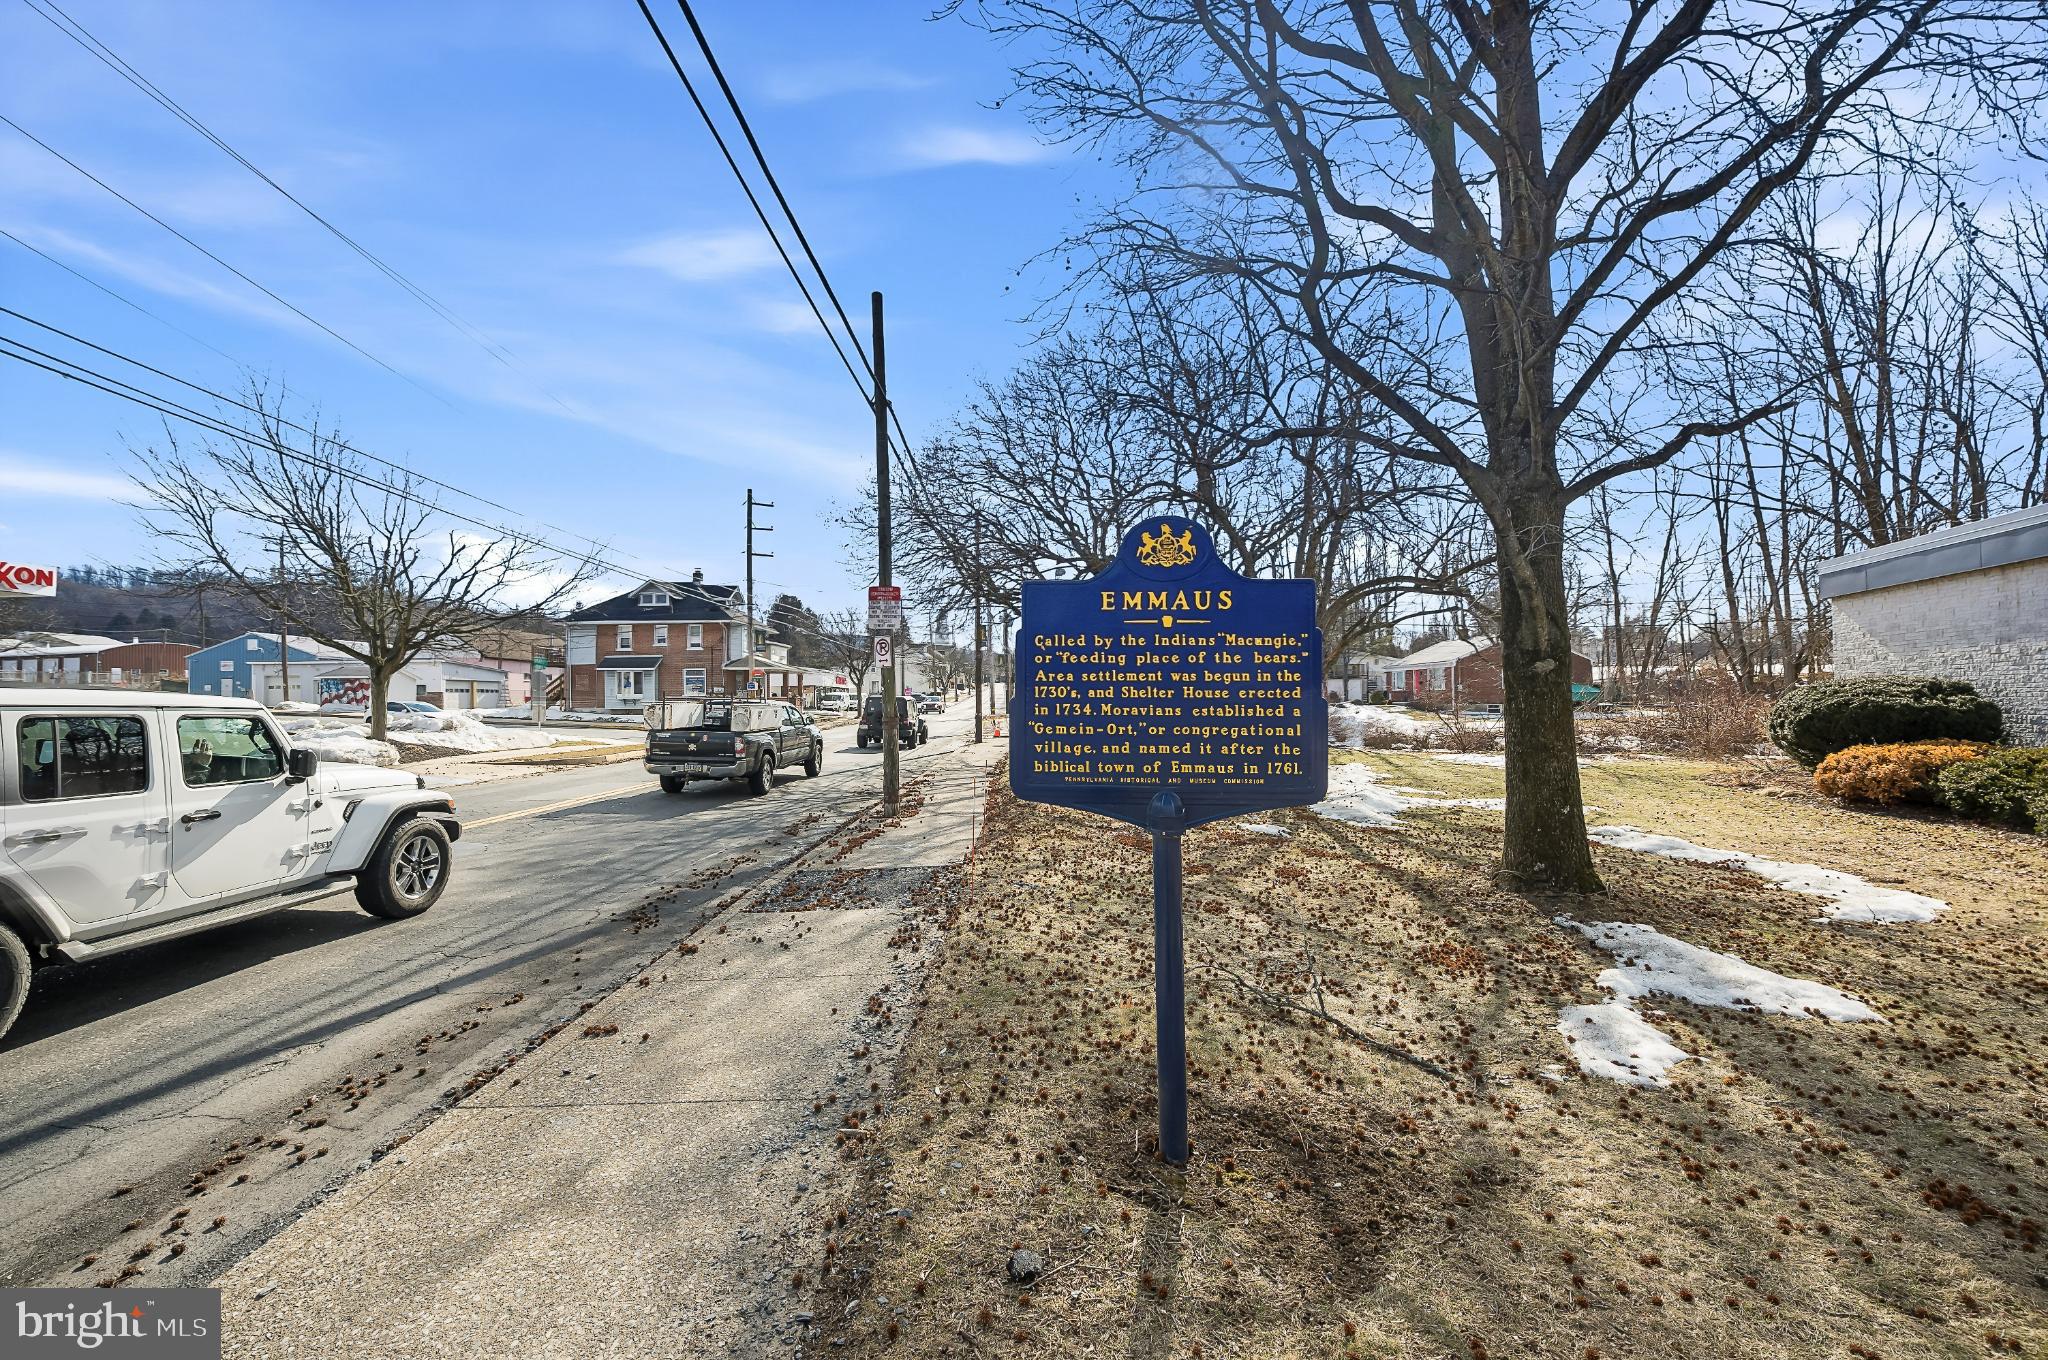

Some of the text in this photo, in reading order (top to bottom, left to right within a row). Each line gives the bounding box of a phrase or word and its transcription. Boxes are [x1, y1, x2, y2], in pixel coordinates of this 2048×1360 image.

[0, 562, 53, 590] XON
[1100, 590, 1233, 611] EMMAUS
[1034, 634, 1086, 647] Called
[1095, 634, 1113, 649] by
[1121, 634, 1146, 646] the
[1154, 634, 1216, 646] Indians
[1035, 651, 1309, 666] or "feeding place of the bears."
[1035, 669, 1302, 685] Area settlement was begun in the
[1034, 686, 1302, 699] 1730's, and Shelter House erected
[1034, 703, 1302, 717] in 1734. Moravians established a
[1148, 726, 1166, 735] or
[1173, 723, 1302, 739] congregational
[1034, 741, 1301, 756] village, and named it after the
[1034, 760, 1303, 775] biblical town of Emmaus in 1761.
